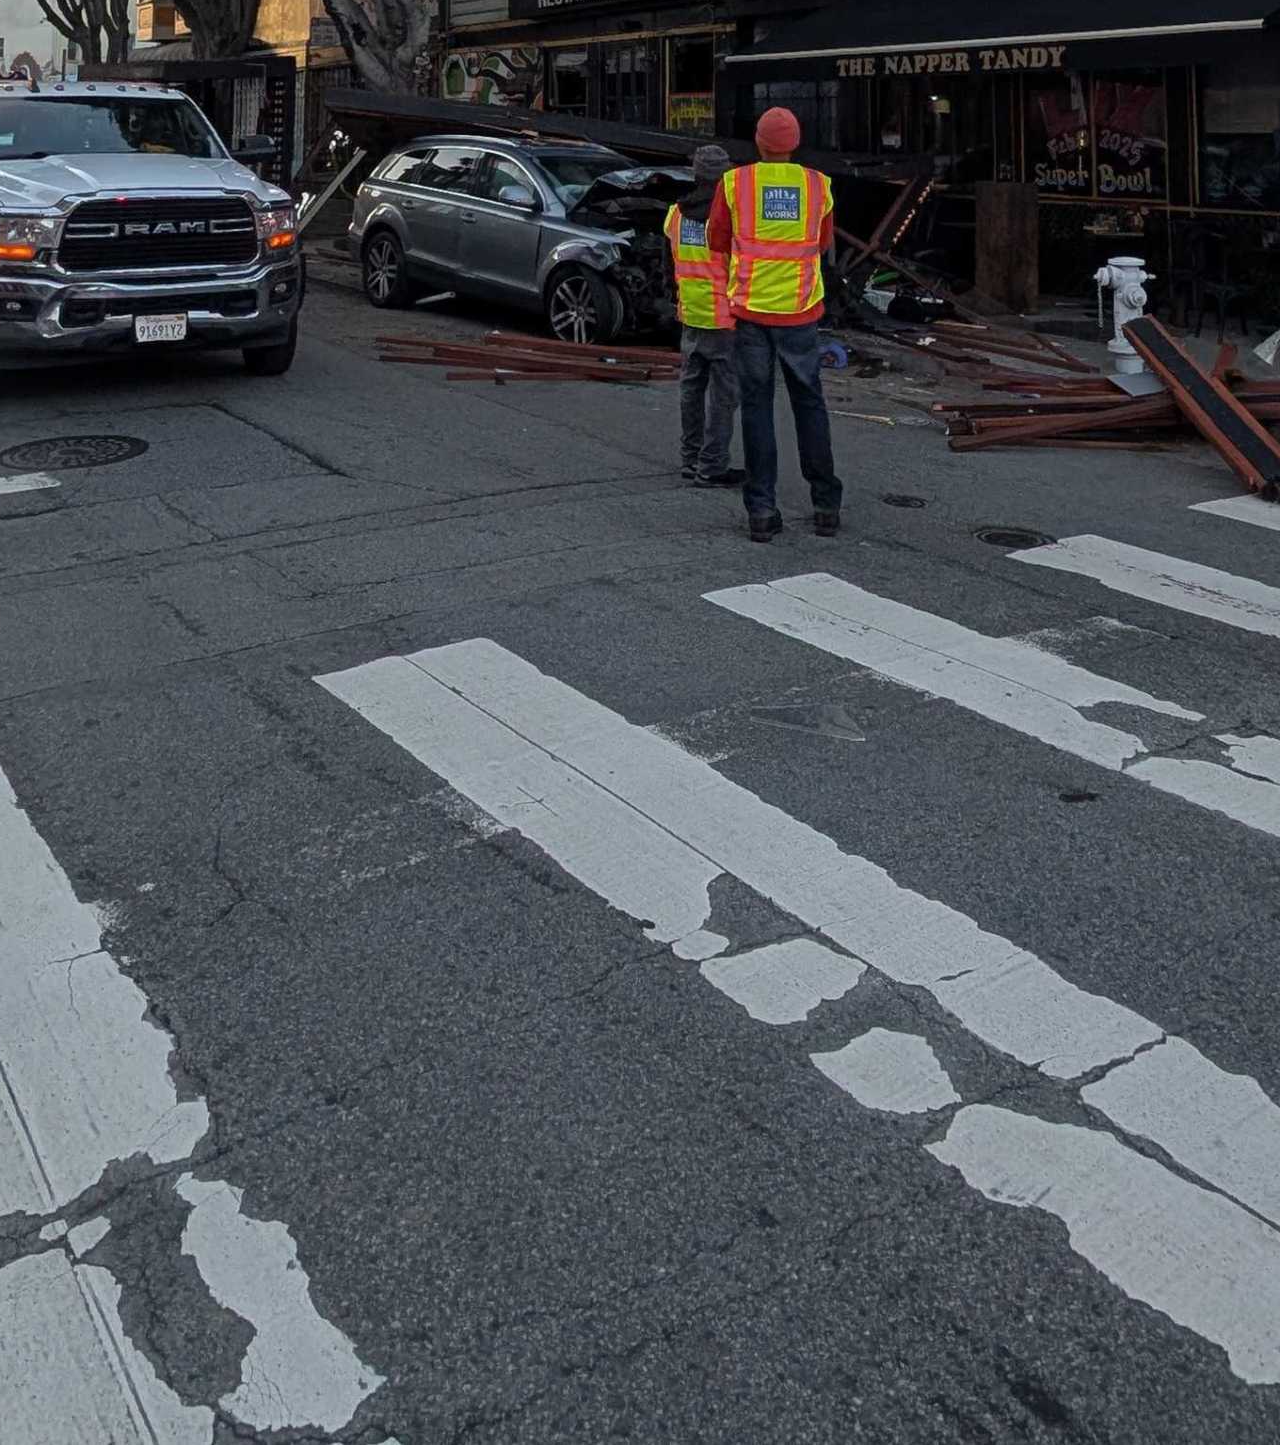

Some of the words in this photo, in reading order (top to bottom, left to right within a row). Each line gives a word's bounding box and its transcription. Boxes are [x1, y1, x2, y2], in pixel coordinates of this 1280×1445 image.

[836, 57, 875, 77] THE
[884, 52, 969, 75] NAPPER
[979, 46, 1066, 69] TANDY
[1034, 162, 1089, 191] Super
[1097, 163, 1153, 194] Bowl
[764, 210, 798, 219] WORKS
[125, 221, 205, 235] RAM
